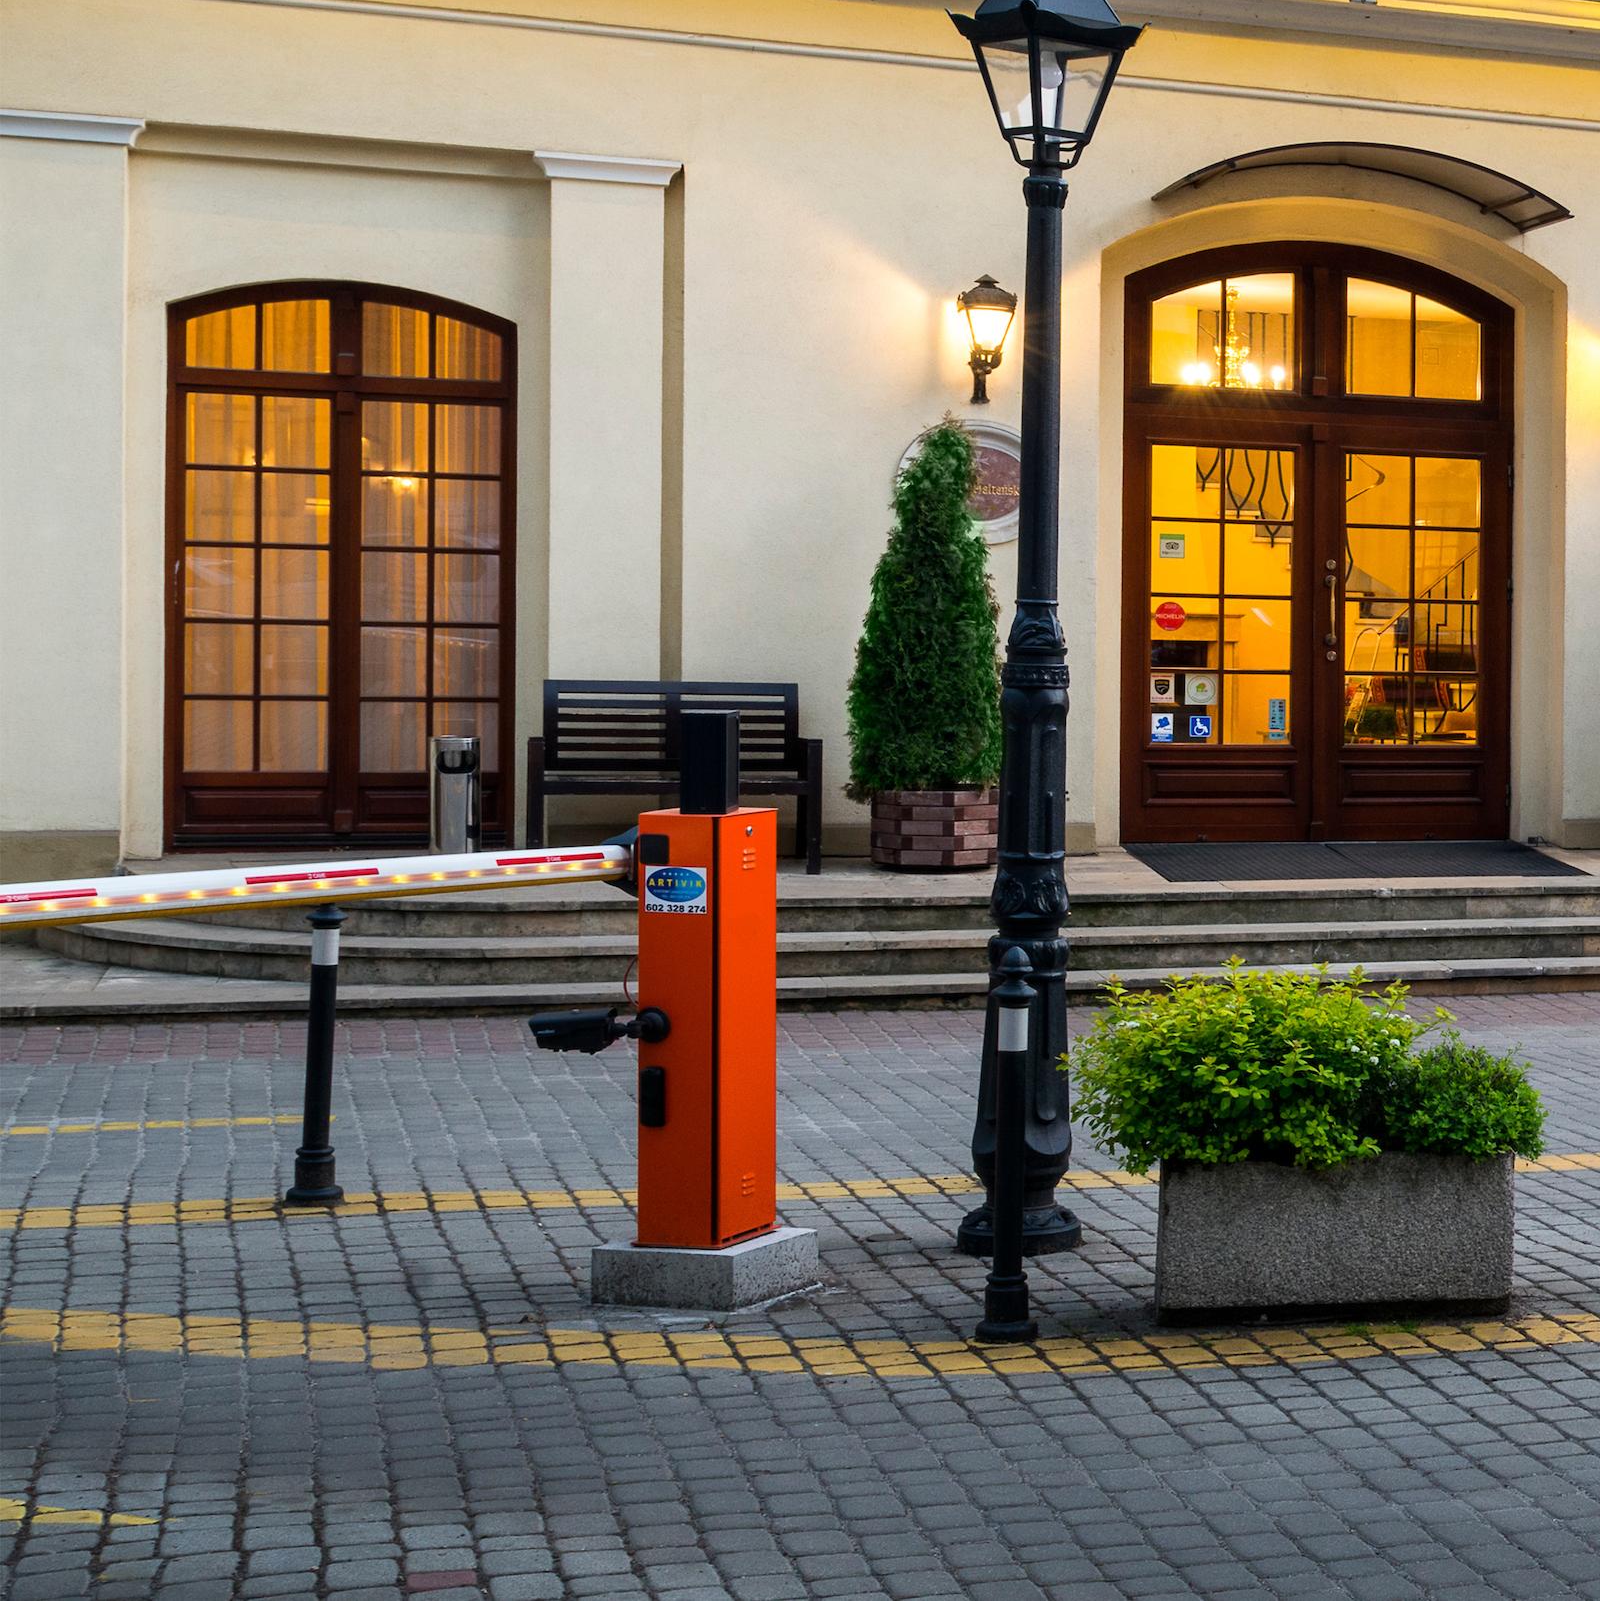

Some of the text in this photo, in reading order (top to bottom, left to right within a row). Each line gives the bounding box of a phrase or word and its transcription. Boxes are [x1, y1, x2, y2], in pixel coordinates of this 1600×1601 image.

[648, 878, 703, 887] ARTIVIK
[646, 904, 706, 913] 602 328 274
